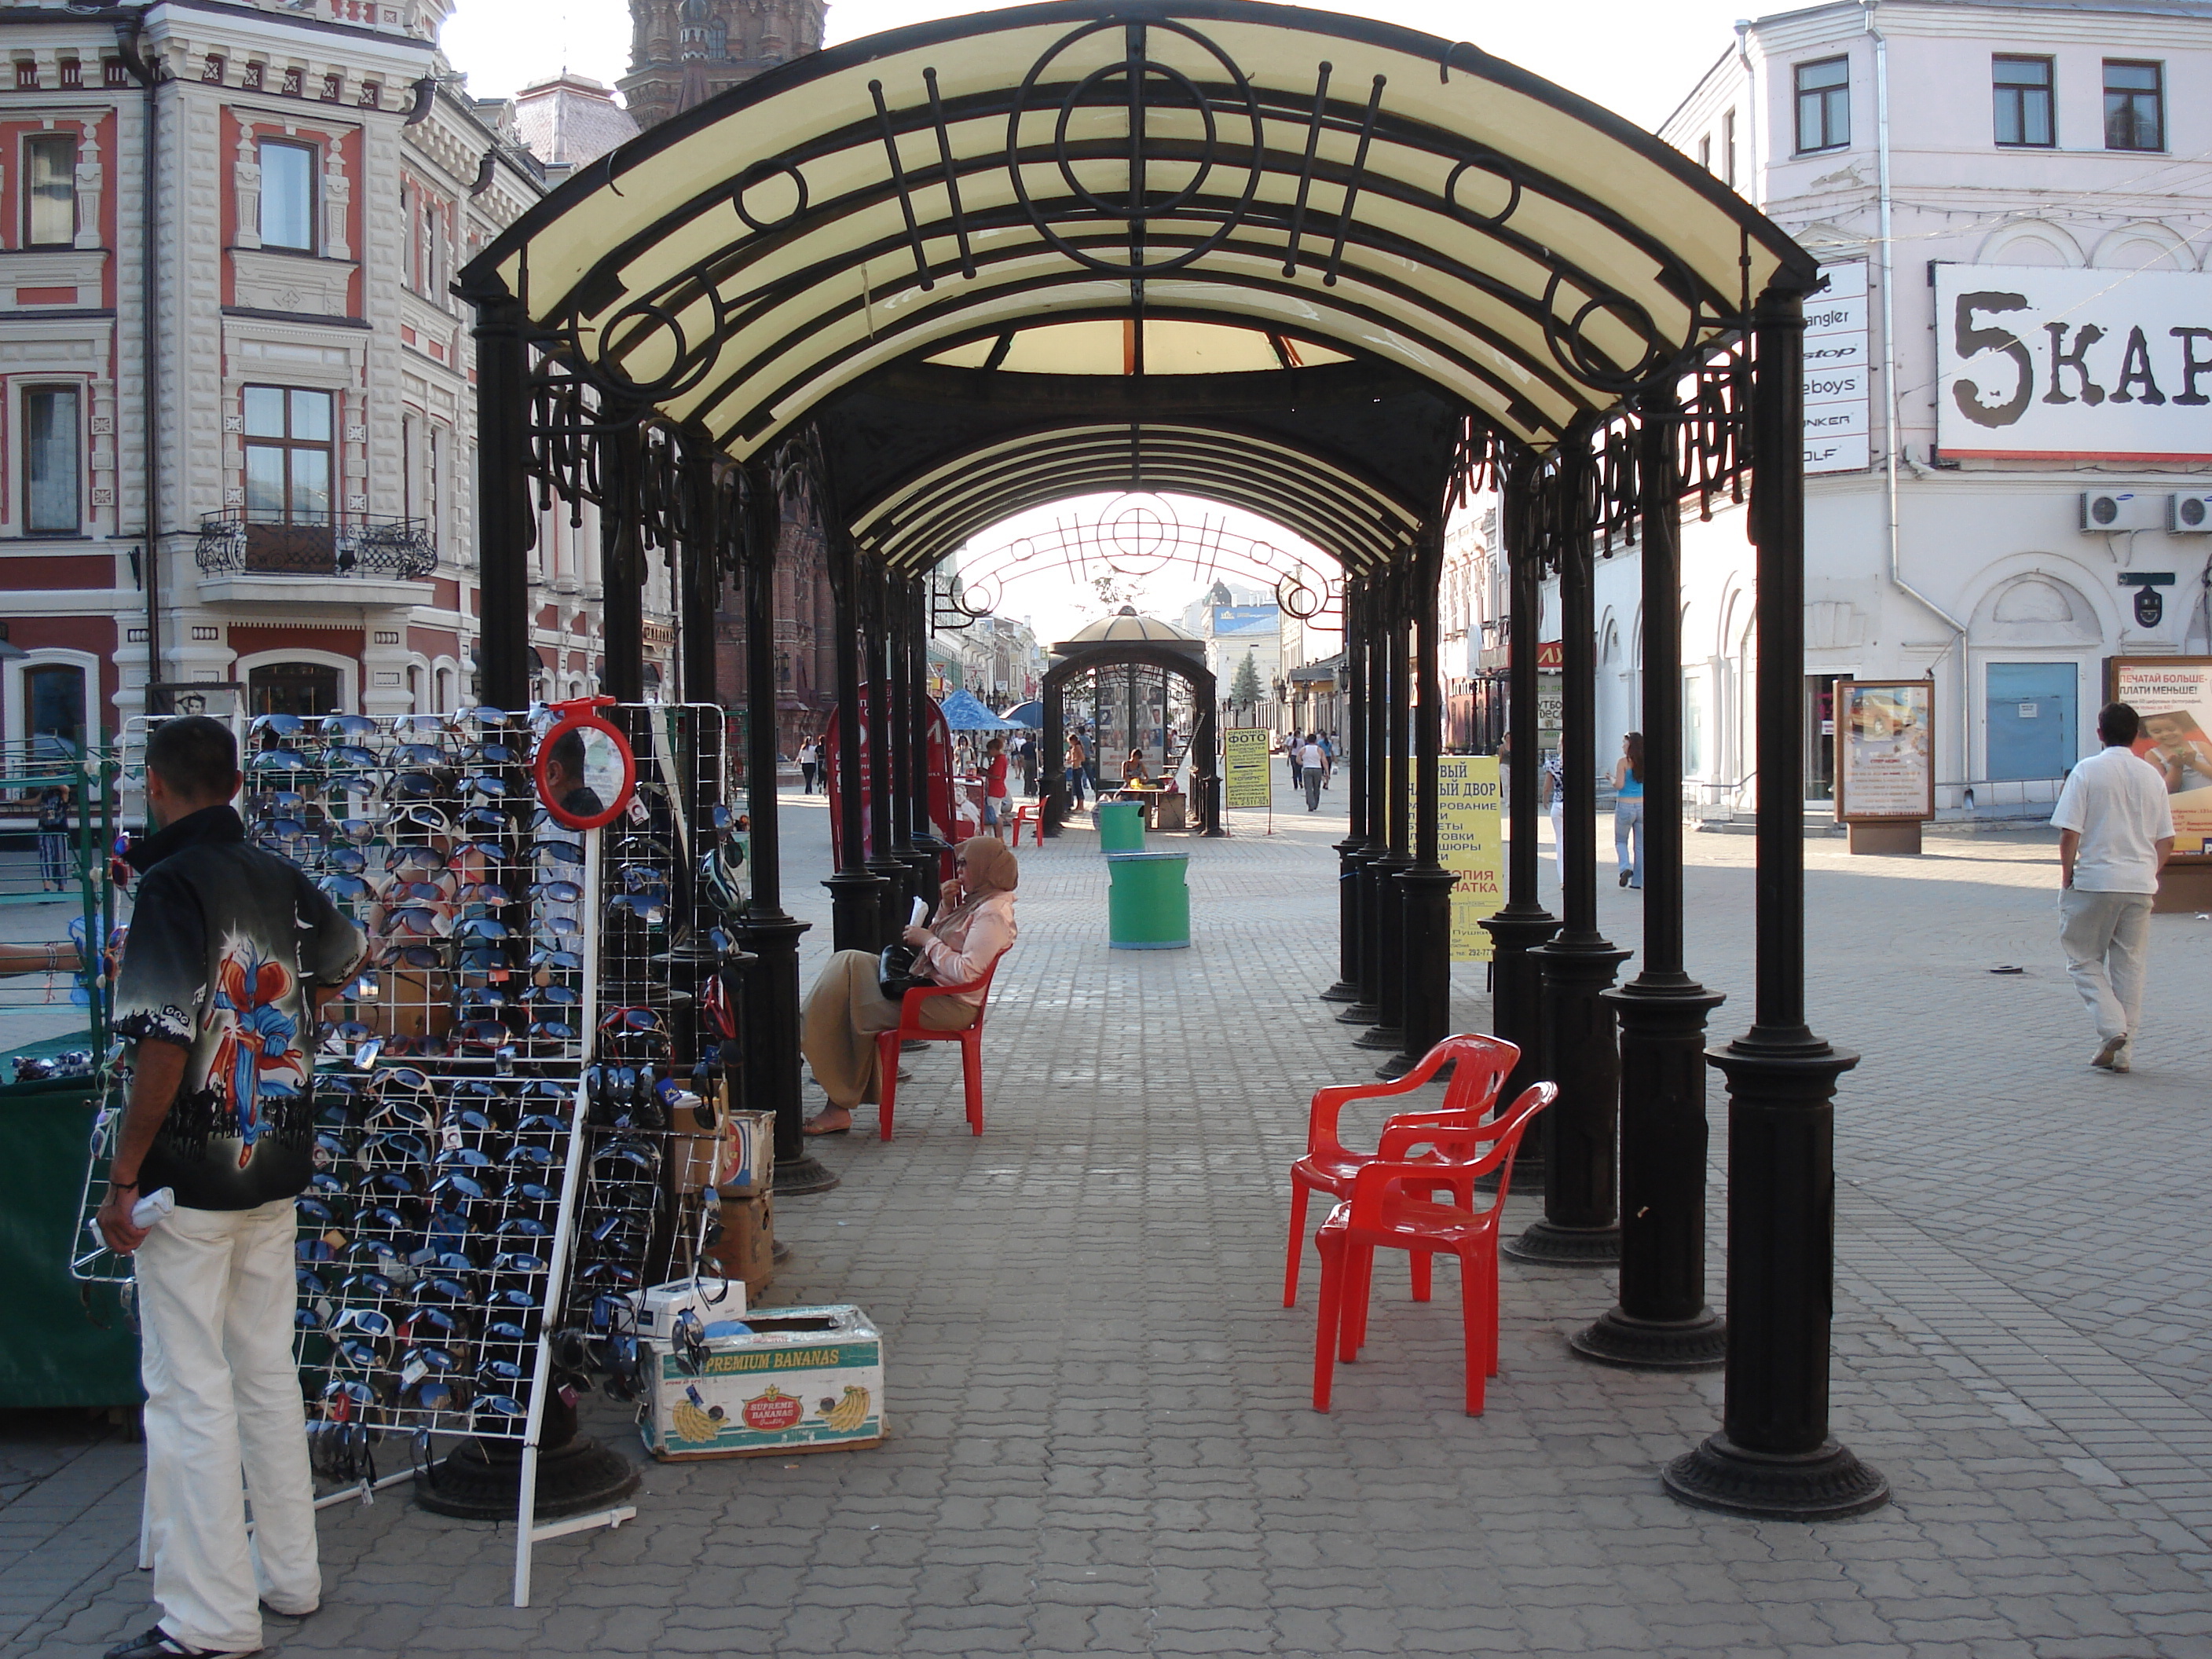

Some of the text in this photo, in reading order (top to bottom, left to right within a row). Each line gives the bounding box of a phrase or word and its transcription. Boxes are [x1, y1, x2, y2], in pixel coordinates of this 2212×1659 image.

[1806, 311, 1849, 327] angler
[1804, 347, 1856, 361] stop
[1953, 291, 2033, 429] 5
[1804, 379, 1855, 394] eboys
[1804, 416, 1850, 427] NKER
[2120, 673, 2161, 683] ПЕЧАТАЙ
[1229, 734, 1266, 743] ФОТО
[1463, 783, 1496, 798] ДВОР
[1452, 870, 1494, 881] ОПИЯ
[1452, 882, 1498, 893] ЧАТКА
[705, 1350, 840, 1372] PREMIUM BANANAS
[750, 1401, 793, 1411] SUPREME
[752, 1409, 794, 1419] BANANAS
